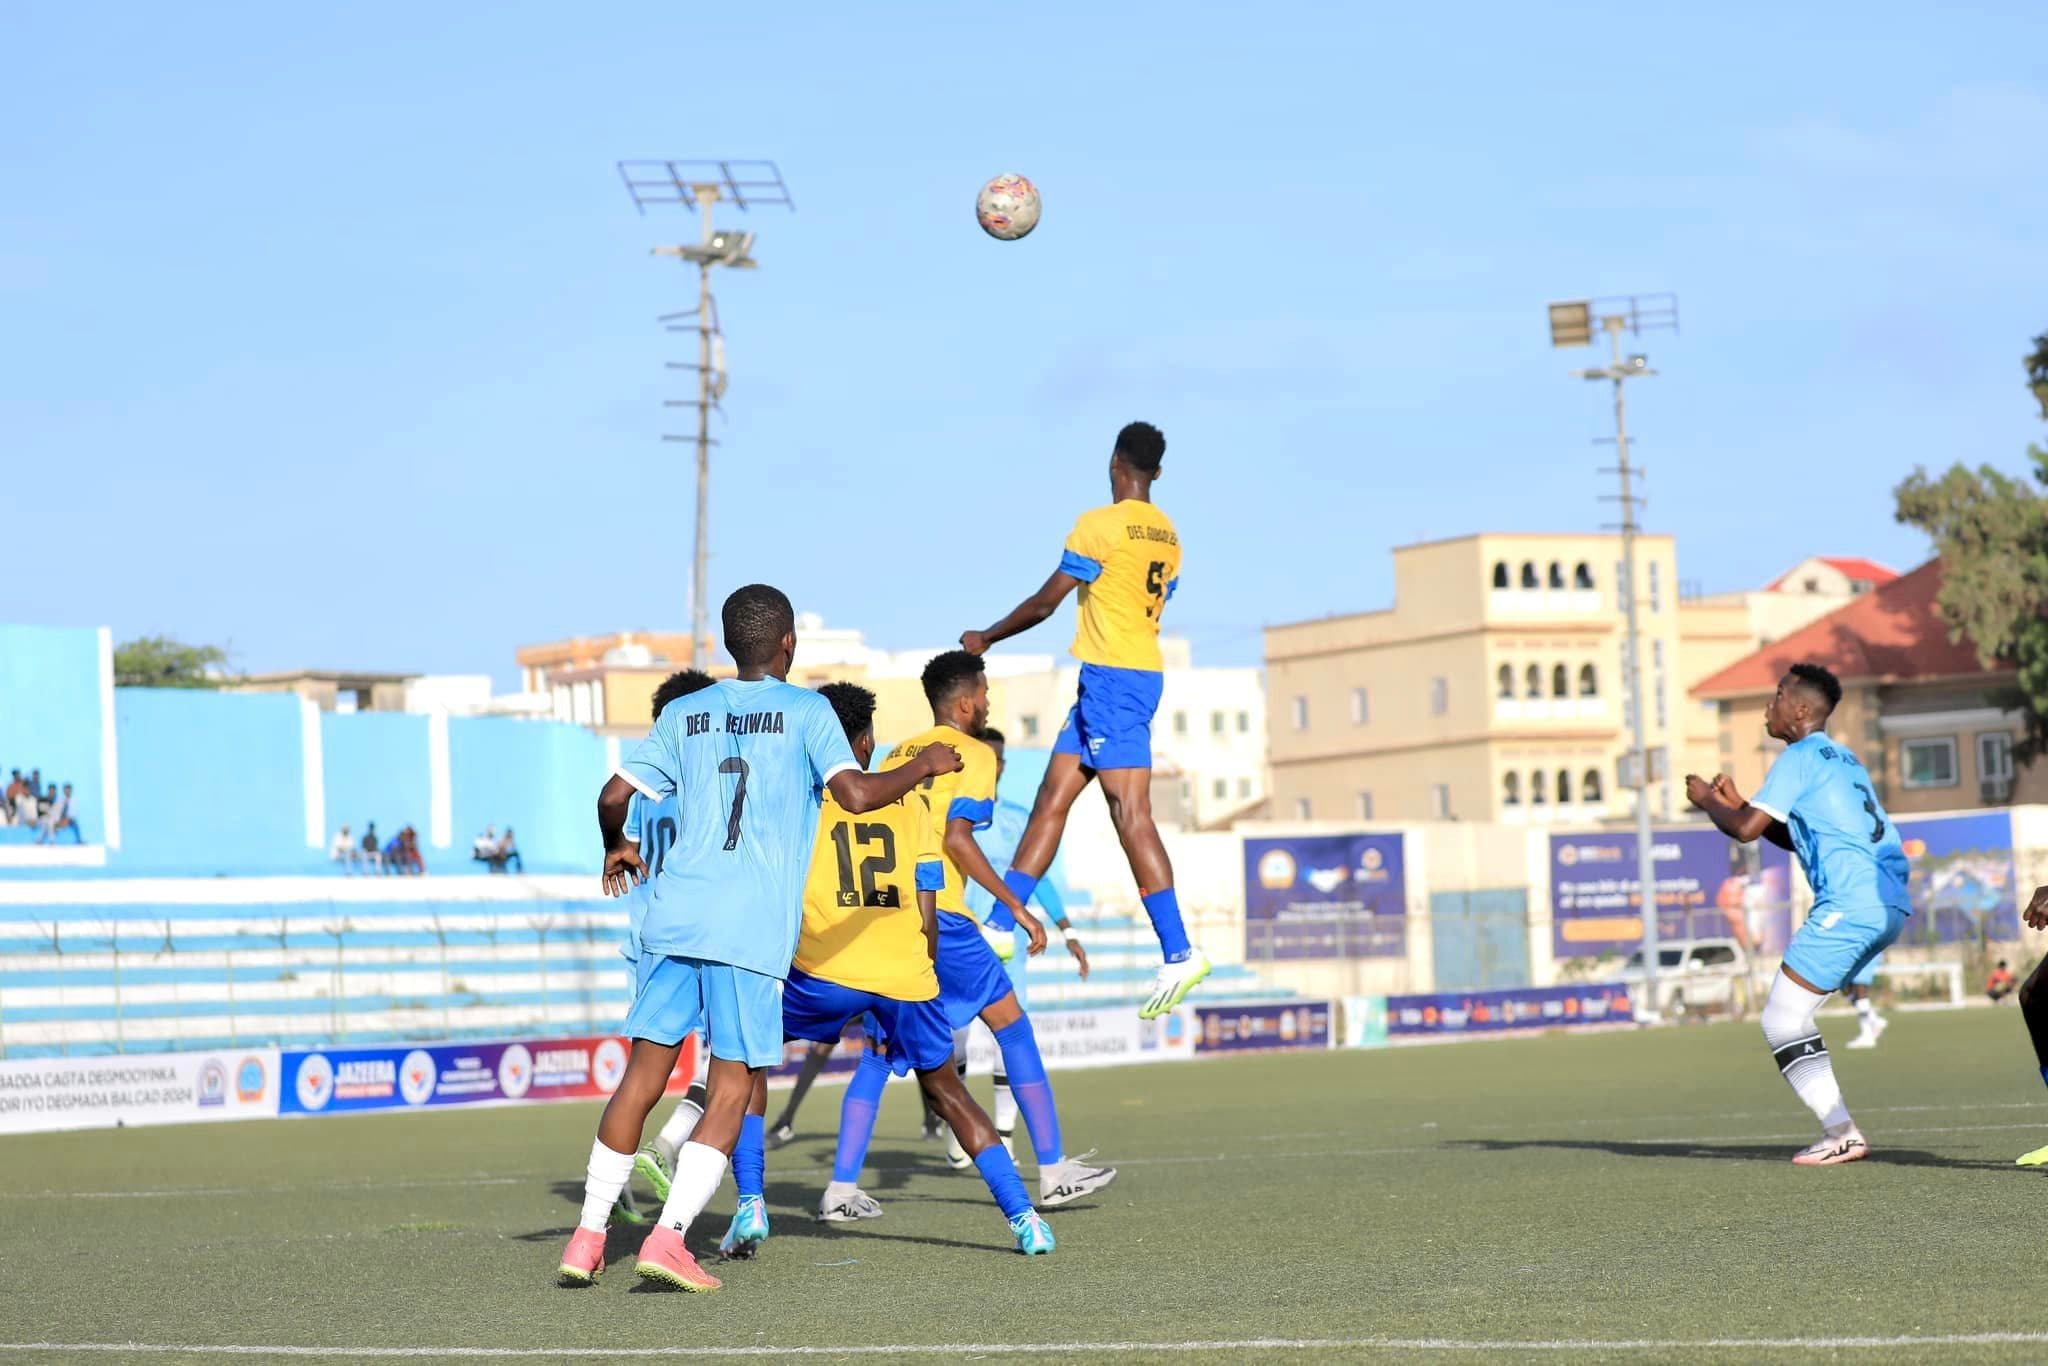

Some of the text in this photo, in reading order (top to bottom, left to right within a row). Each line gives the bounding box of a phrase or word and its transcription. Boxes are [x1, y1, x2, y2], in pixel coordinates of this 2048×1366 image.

[686, 711, 711, 737] DEG
[718, 756, 750, 850] 7
[1853, 781, 1885, 843] 3
[830, 821, 900, 908] 12
